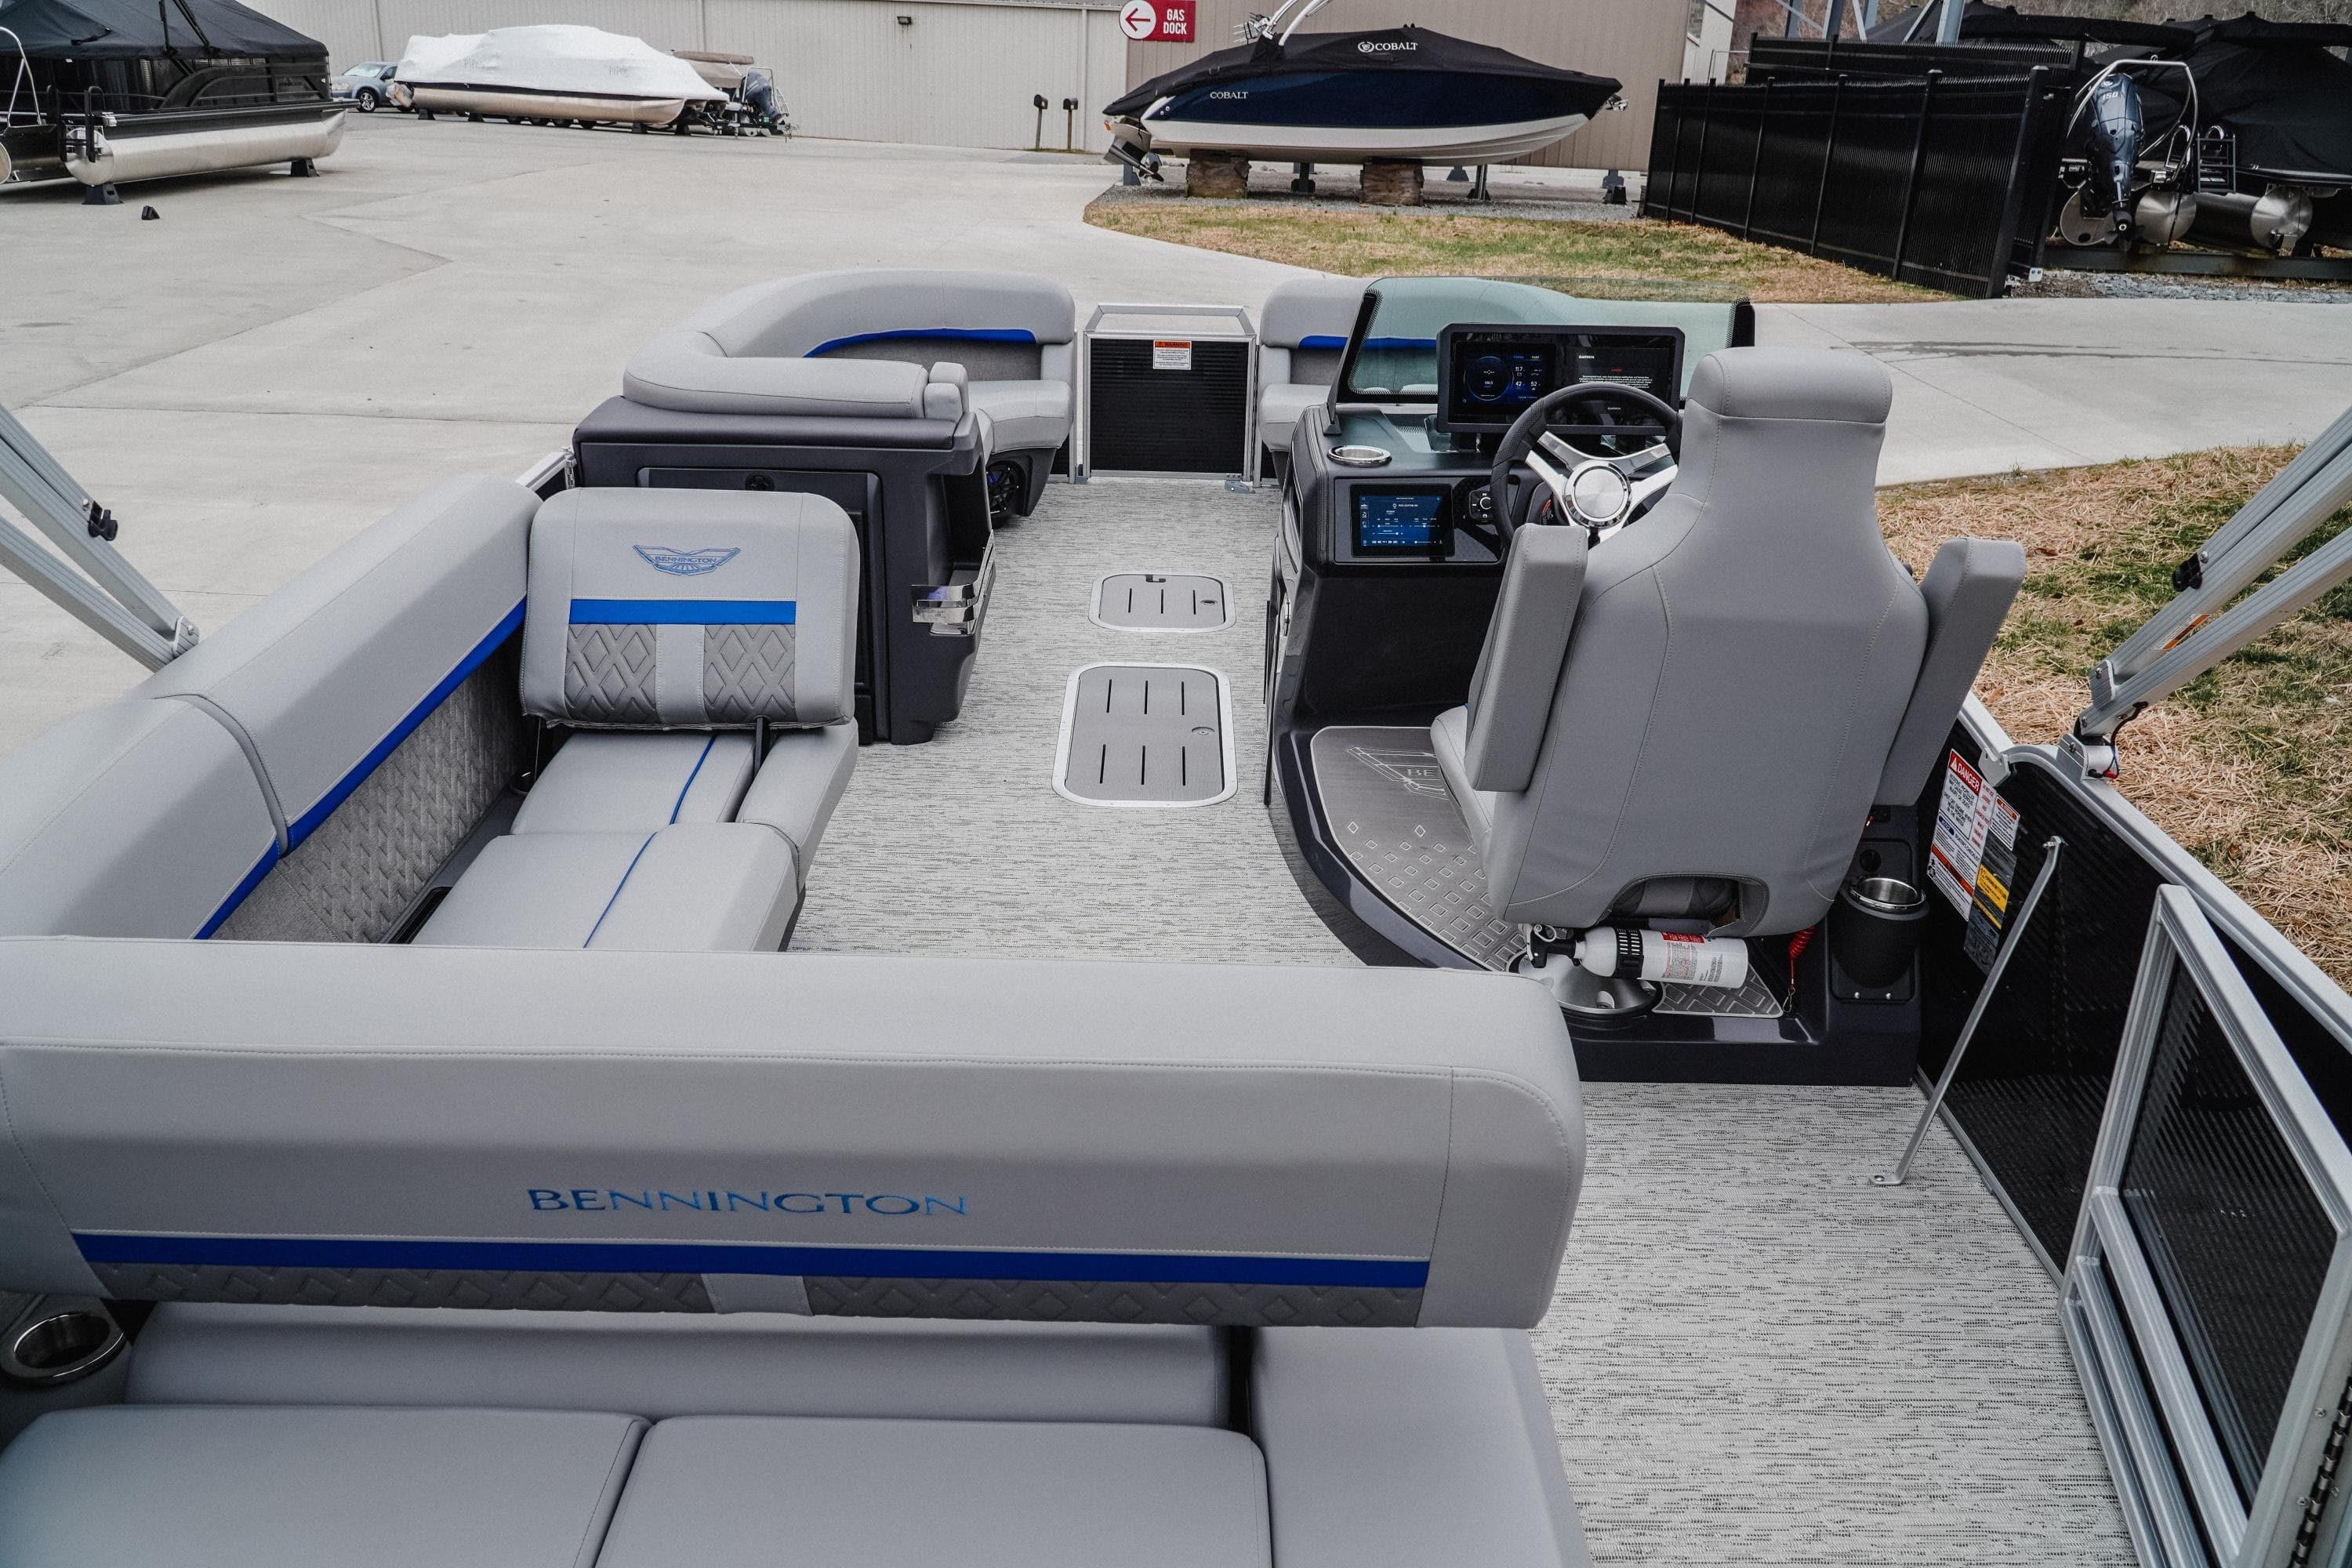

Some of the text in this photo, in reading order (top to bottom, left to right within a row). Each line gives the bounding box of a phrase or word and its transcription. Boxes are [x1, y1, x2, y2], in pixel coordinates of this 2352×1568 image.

[1167, 9, 1185, 20] GAS
[1163, 22, 1187, 34] DOCK
[2102, 91, 2118, 100] 150
[1957, 763, 1980, 792] DANGER
[526, 1188, 970, 1216] BENNINGTON
